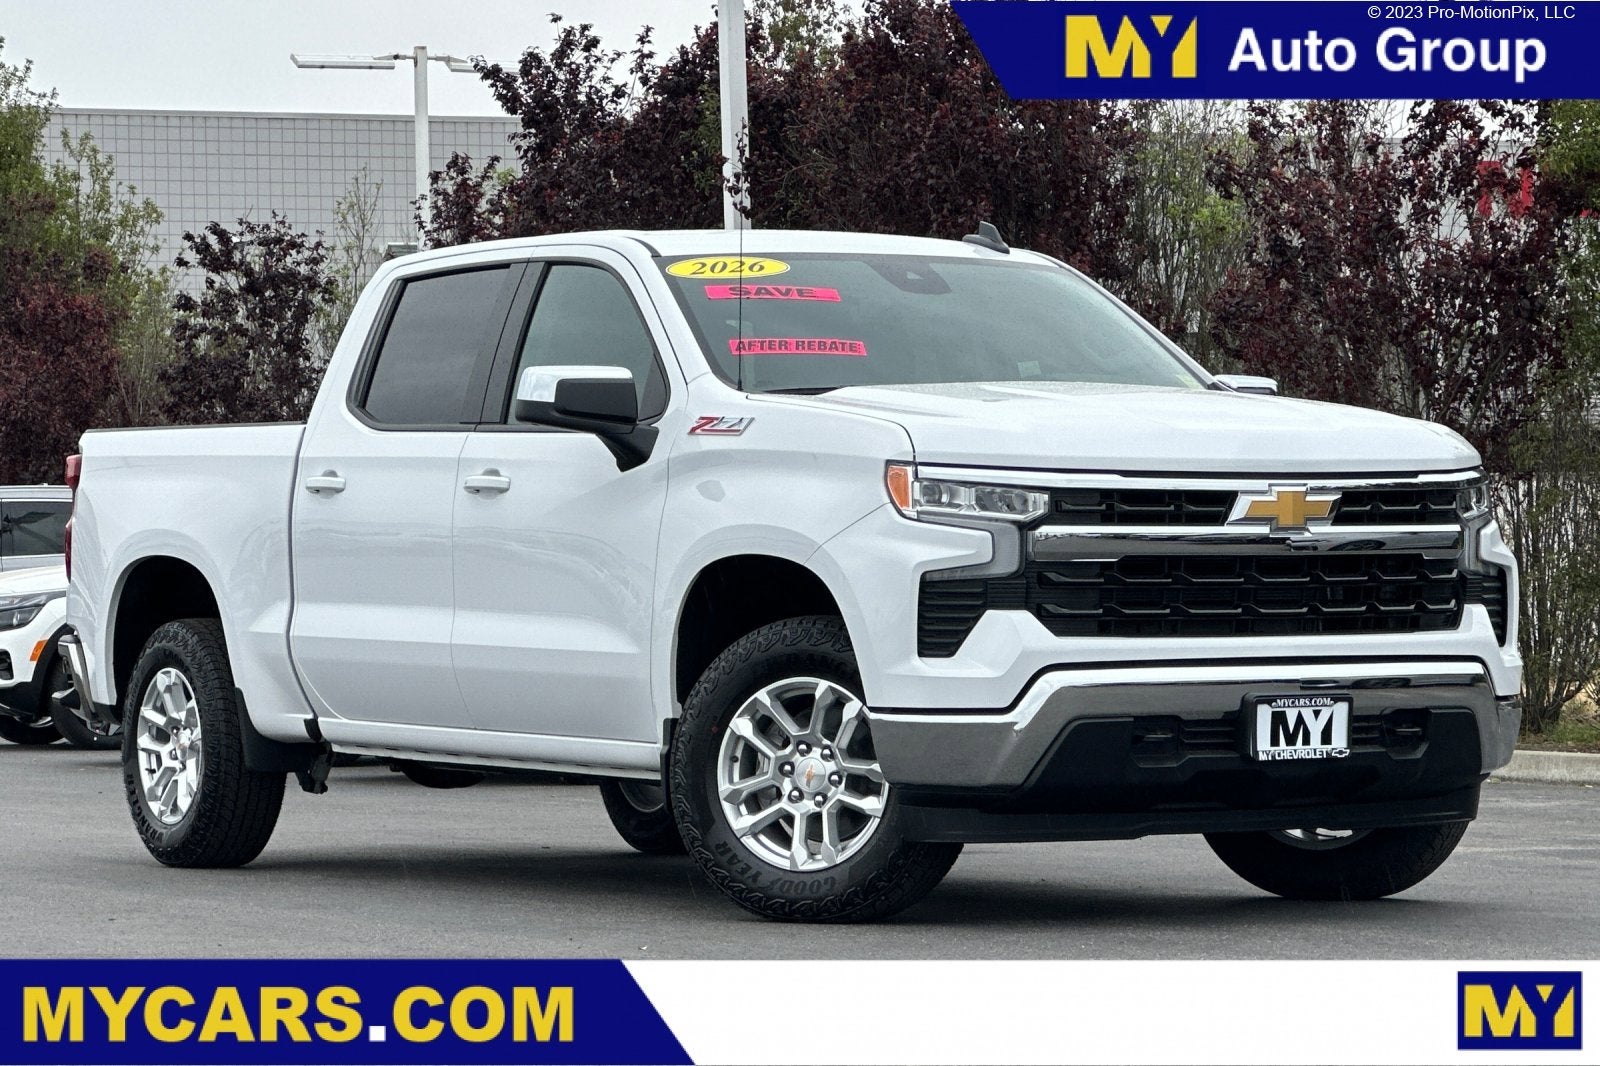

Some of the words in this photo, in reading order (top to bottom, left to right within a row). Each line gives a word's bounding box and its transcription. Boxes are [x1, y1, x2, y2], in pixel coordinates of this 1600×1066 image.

[691, 260, 765, 275] 2026
[729, 286, 816, 298] SAVE
[735, 340, 790, 352] AFTER
[1276, 699, 1331, 707] MYCARS.COM
[1271, 709, 1334, 747] MY
[1259, 750, 1273, 761] MY
[1275, 749, 1327, 760] CHEVROLET
